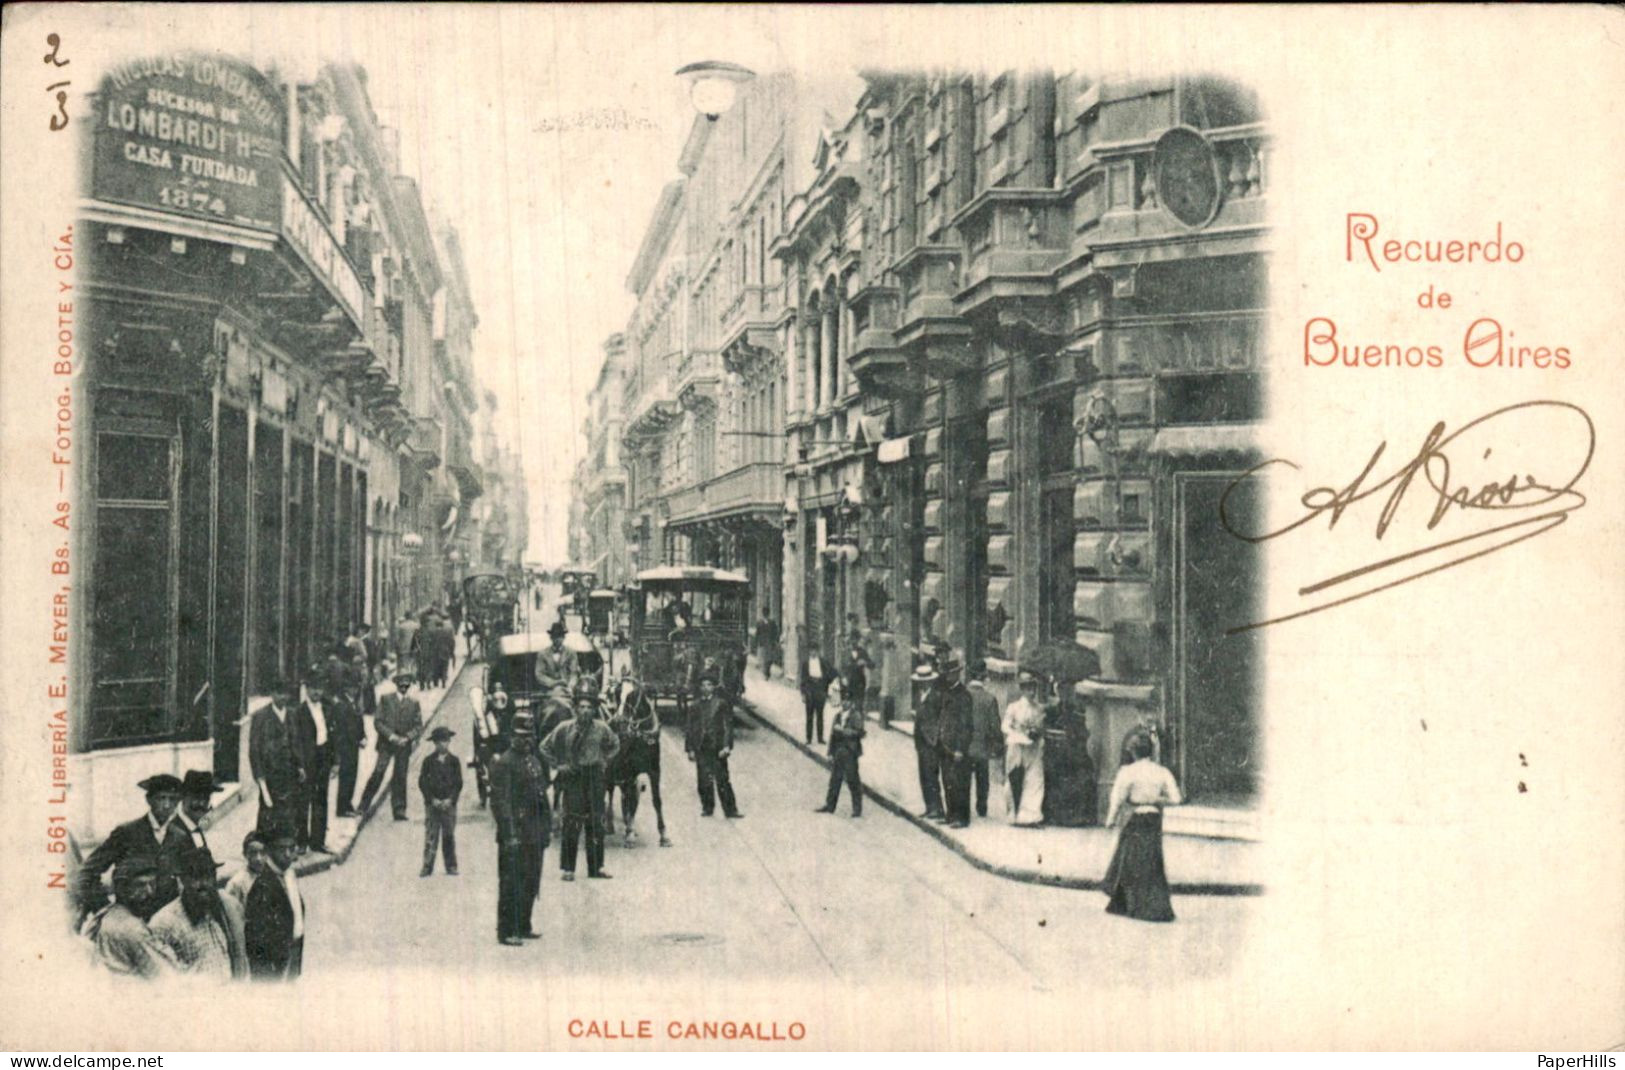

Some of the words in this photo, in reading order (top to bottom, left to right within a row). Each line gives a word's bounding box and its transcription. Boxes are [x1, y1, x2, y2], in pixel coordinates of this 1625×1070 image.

[107, 100, 227, 153] LOMBARDI
[123, 141, 172, 169] CASA
[180, 153, 258, 187] FUNDADA
[158, 186, 227, 217] 1874
[1346, 212, 1525, 272] Recuerdo
[1416, 284, 1452, 309] de
[52, 304, 73, 376] BOOTE
[1303, 316, 1444, 368] Buenos
[1462, 316, 1572, 370] Aires
[48, 586, 71, 663] MEYER,
[47, 675, 67, 698] E.
[47, 710, 67, 804] LIBRERÍA
[47, 815, 67, 853] 561
[47, 862, 66, 889] N.
[567, 1018, 654, 1040] CALLE
[666, 1020, 807, 1042] CANGALLO
